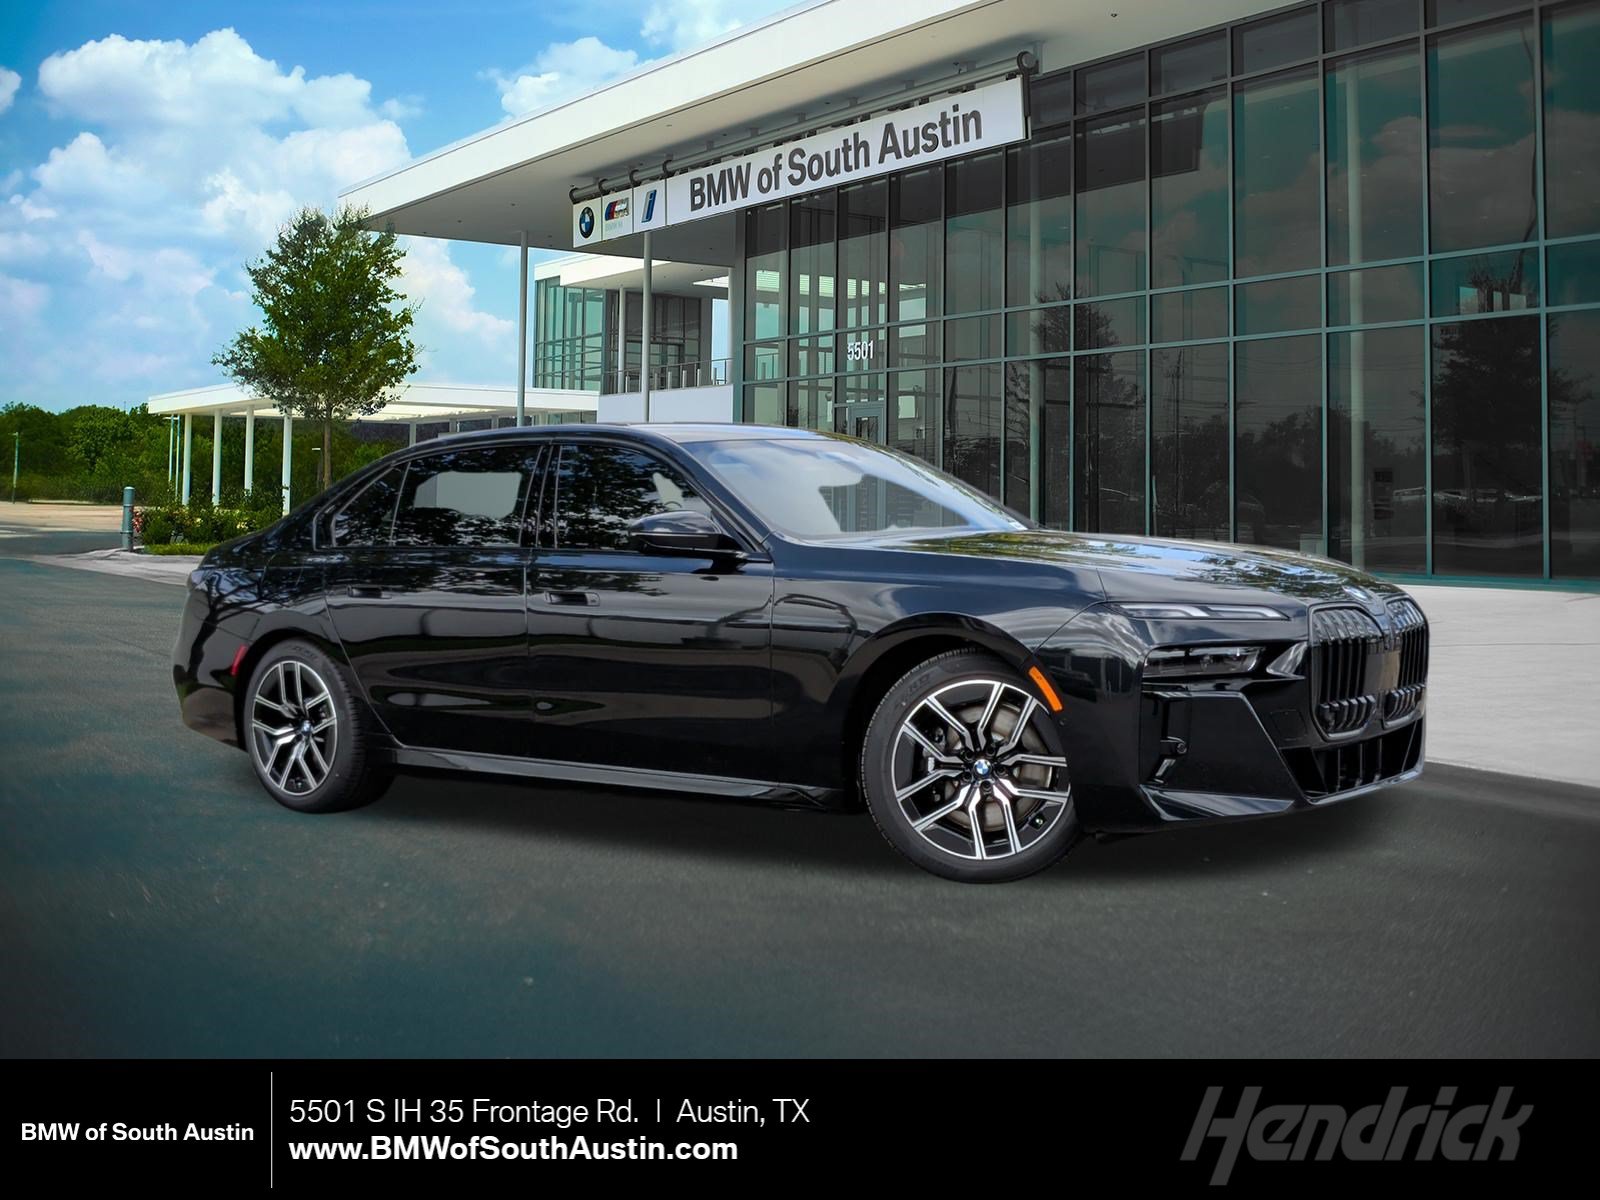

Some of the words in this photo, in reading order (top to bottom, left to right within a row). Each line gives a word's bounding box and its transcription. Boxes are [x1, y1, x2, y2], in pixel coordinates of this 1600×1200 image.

[690, 162, 752, 212] BMW
[757, 153, 783, 194] of
[787, 131, 870, 186] South
[878, 104, 982, 165] Austin
[847, 340, 874, 361] 5501
